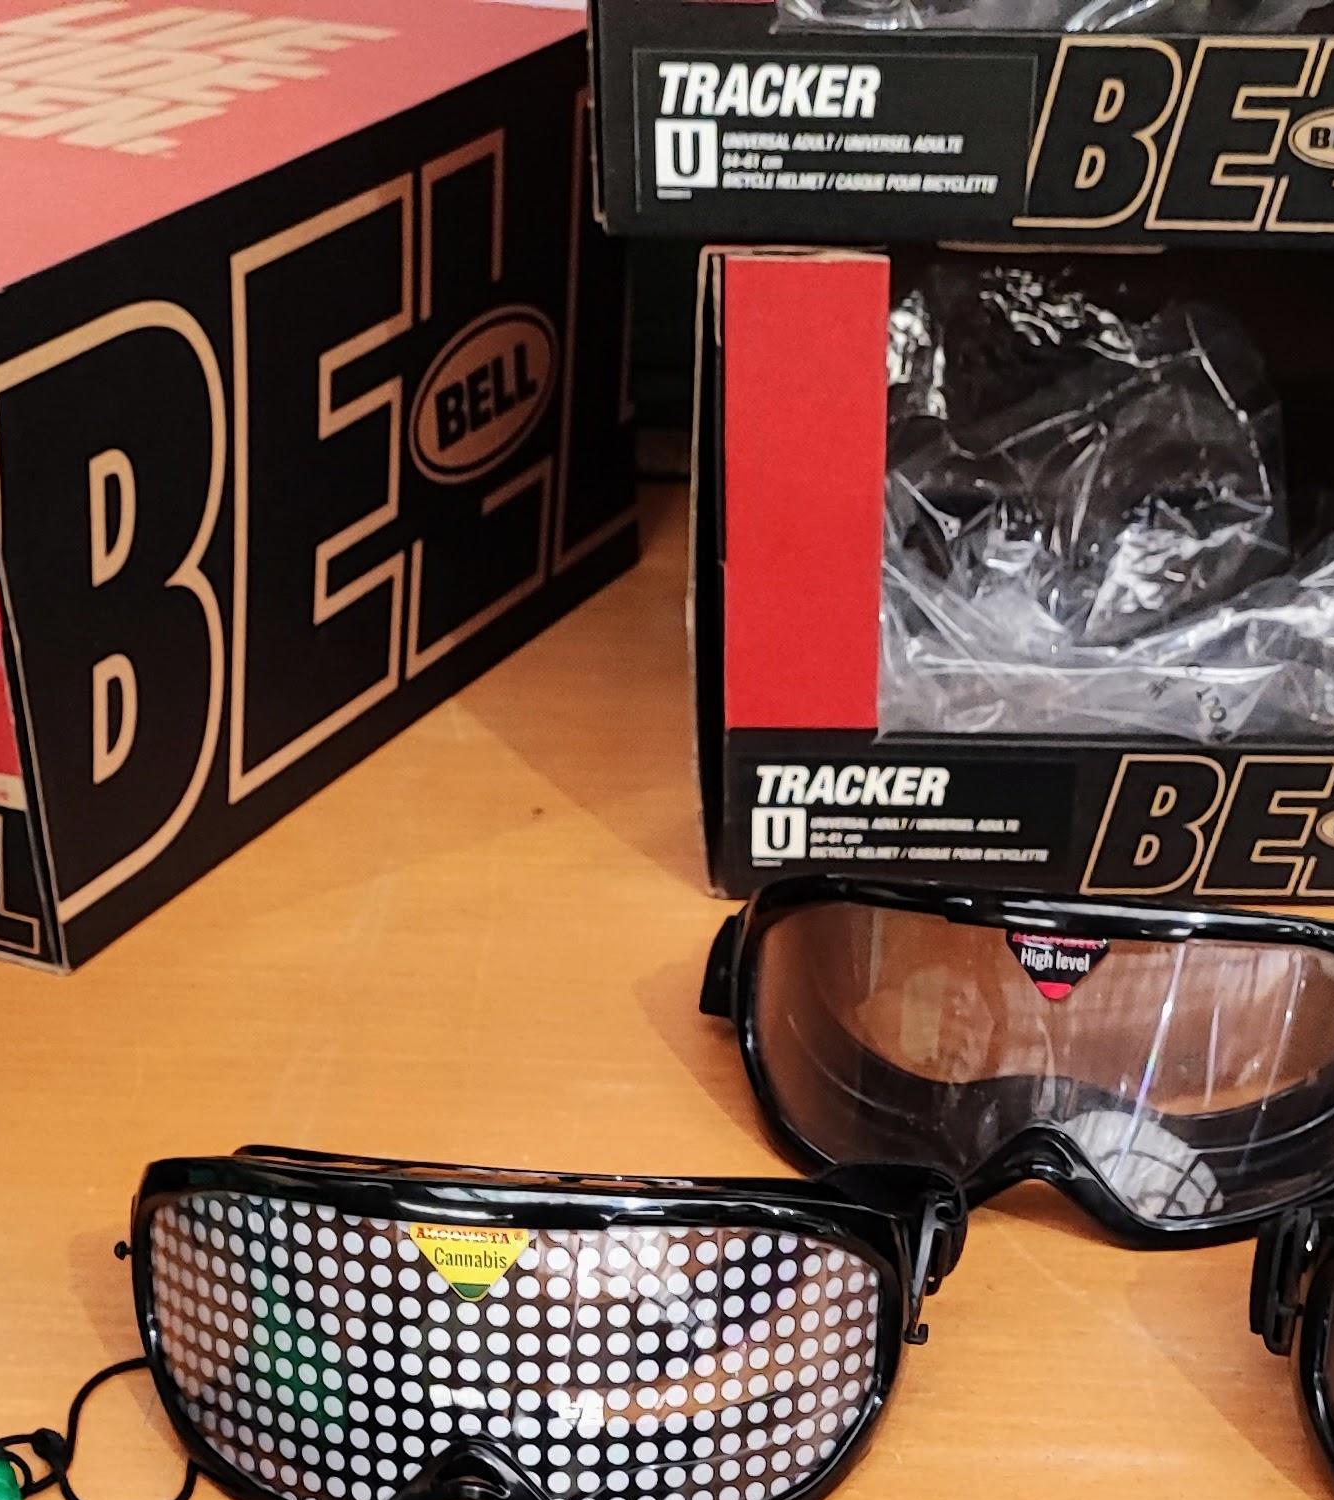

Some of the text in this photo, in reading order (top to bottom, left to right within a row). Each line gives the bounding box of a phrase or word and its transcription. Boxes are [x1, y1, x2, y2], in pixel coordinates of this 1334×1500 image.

[658, 61, 882, 118] TRACKER
[672, 131, 701, 178] U
[435, 340, 538, 452] BELL
[756, 765, 951, 806] TRACKER
[766, 815, 791, 850] U
[1021, 948, 1091, 973] High level
[434, 1247, 507, 1269] Cannabis
